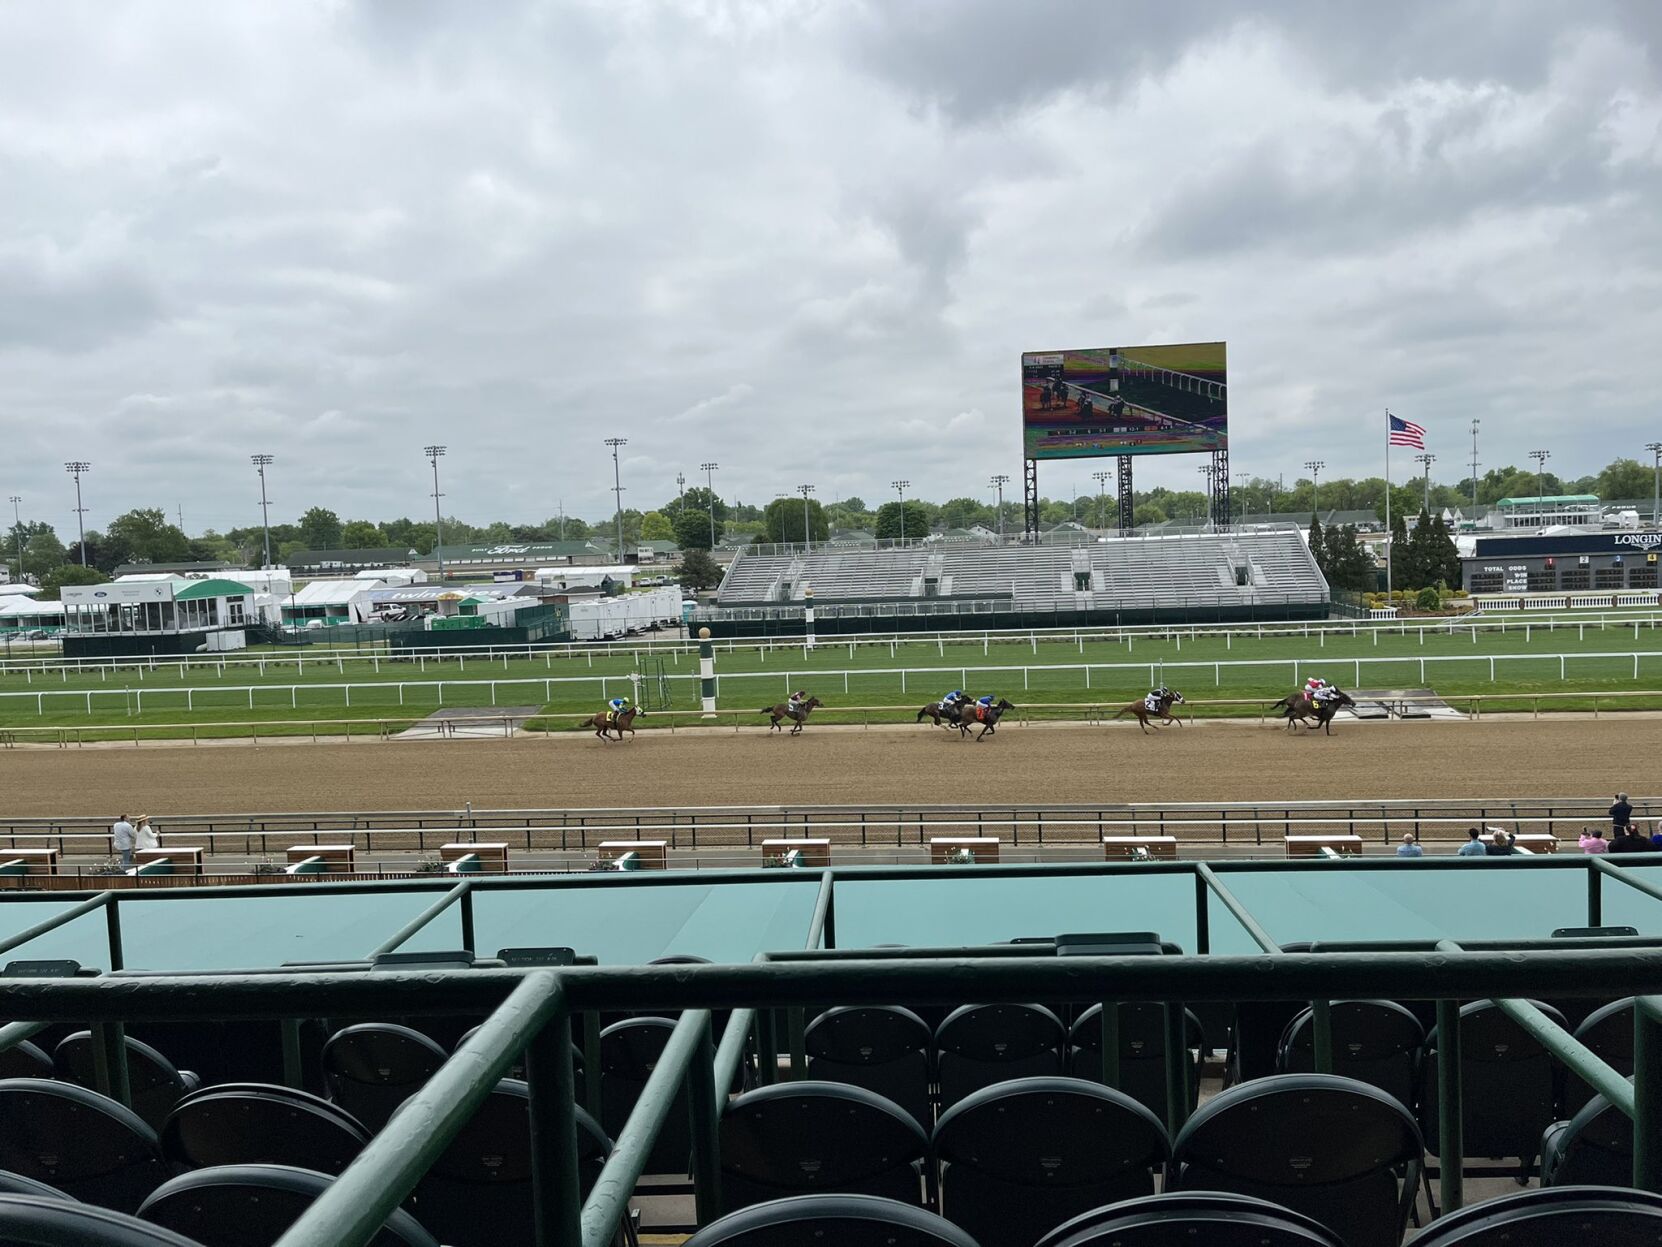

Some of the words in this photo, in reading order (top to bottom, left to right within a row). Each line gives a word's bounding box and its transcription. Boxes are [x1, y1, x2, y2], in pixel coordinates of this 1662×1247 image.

[487, 545, 530, 554] Ford
[938, 701, 944, 710] 3
[1312, 700, 1319, 709] 6
